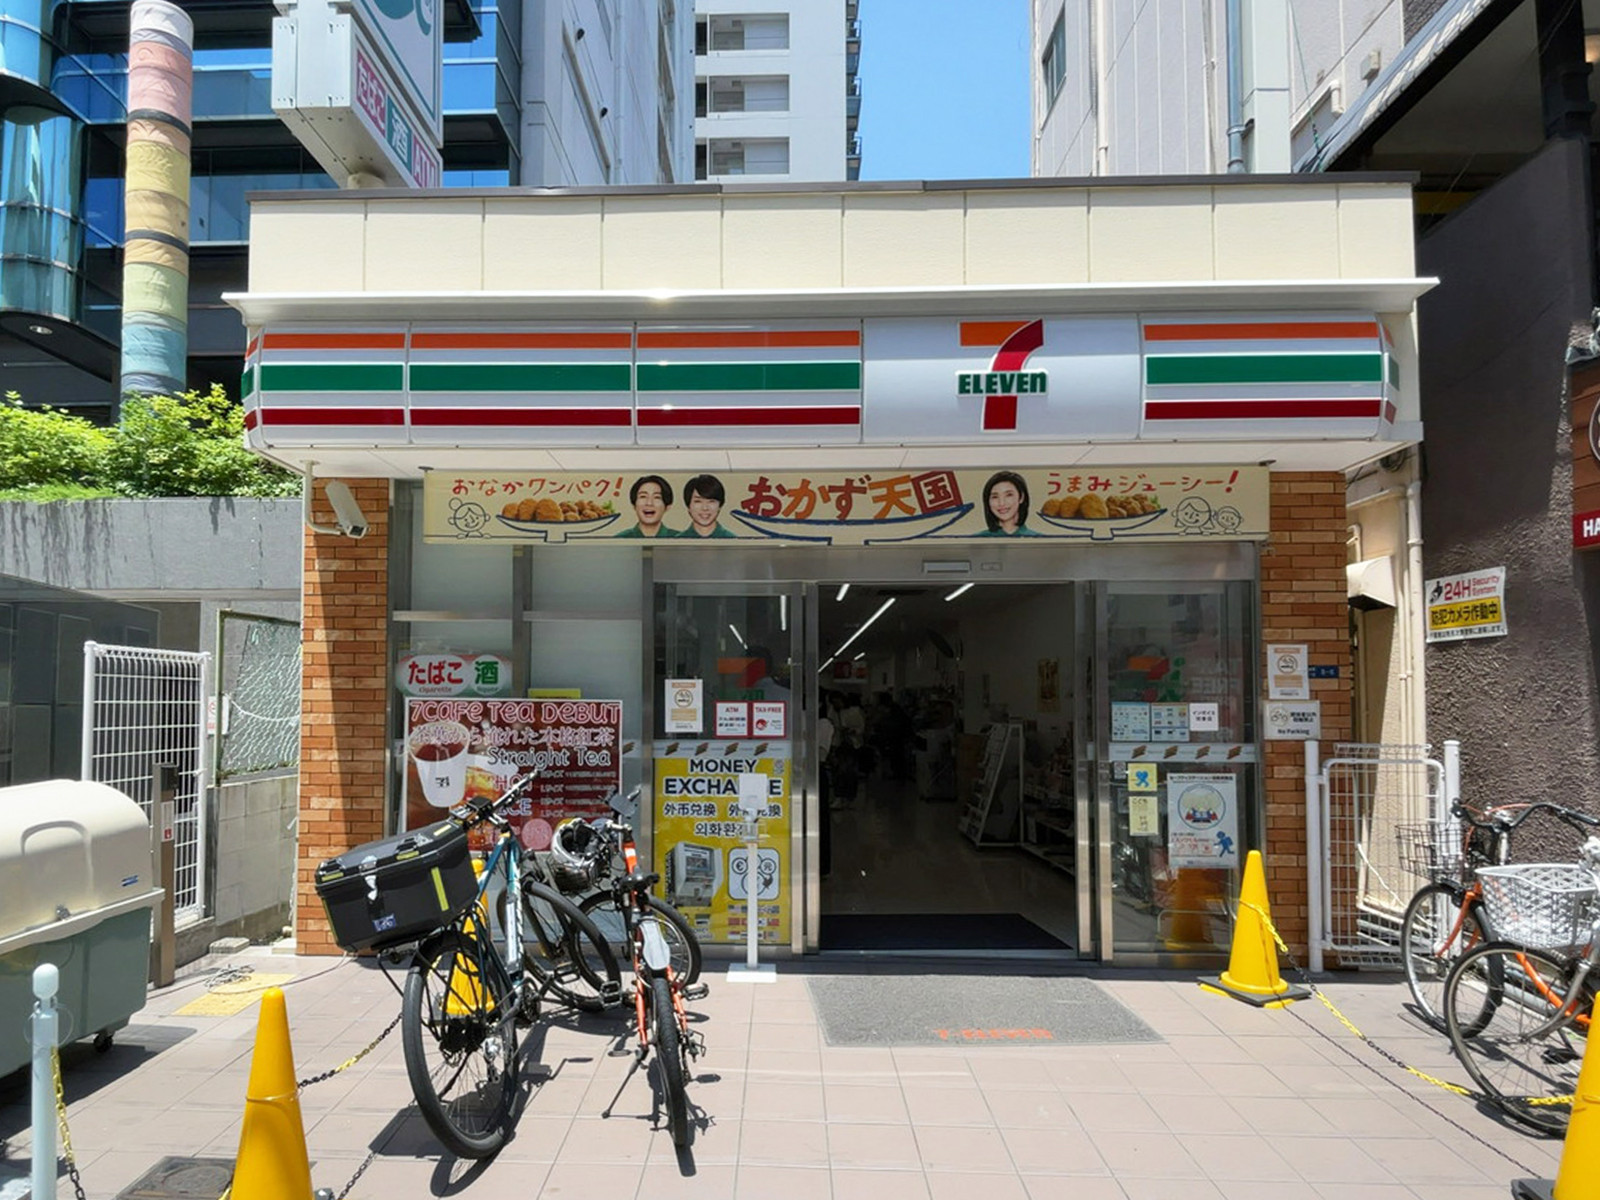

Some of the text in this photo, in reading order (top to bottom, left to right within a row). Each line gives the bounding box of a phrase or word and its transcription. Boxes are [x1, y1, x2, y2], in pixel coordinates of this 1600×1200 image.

[960, 318, 1044, 429] 7
[452, 476, 624, 496] おなかワンパク!
[1047, 470, 1239, 495] うまみジューシー!
[741, 470, 963, 520] おかず天国
[1444, 578, 1471, 601] 24H
[1431, 601, 1498, 626] 防犯カメラ作動中
[409, 660, 499, 685] たばこ 酒
[487, 746, 612, 770] Straight Tea
[690, 759, 758, 773] MONEY
[664, 778, 781, 796] EXCHAE
